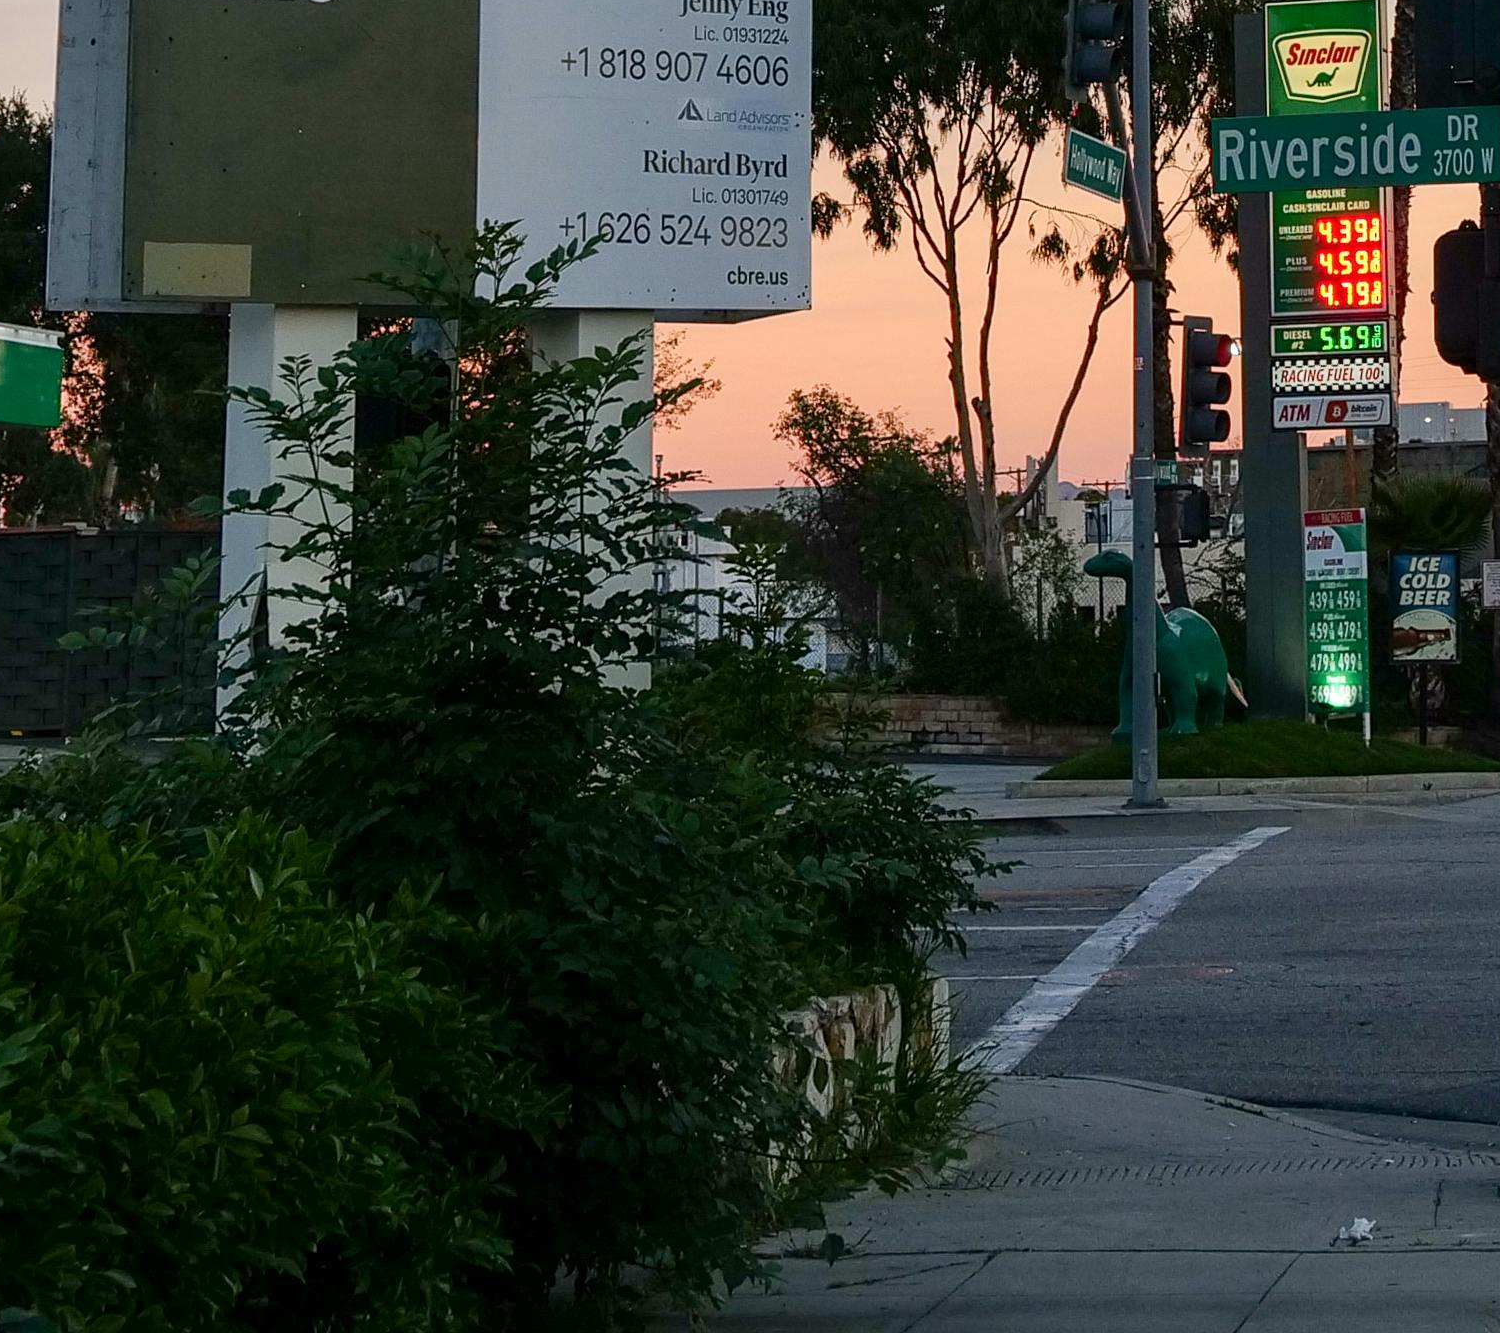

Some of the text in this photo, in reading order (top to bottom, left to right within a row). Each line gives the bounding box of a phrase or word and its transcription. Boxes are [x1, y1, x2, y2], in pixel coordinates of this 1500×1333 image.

[694, 26, 789, 45] Lic. 01931224
[1285, 41, 1361, 66] Sinclair
[560, 47, 789, 87] +1 818 907 4606
[706, 108, 790, 125] Land Advisors
[1447, 113, 1478, 142] DR
[1218, 122, 1421, 182] Riverside
[643, 149, 789, 183] Richard Byrd
[1070, 143, 1122, 193] Hollywood Way
[1433, 147, 1494, 177] 3700 W
[692, 188, 789, 206] Lic. 01301749
[1306, 188, 1346, 199] GASOLINE
[1347, 200, 1370, 210] CARD
[559, 212, 789, 248] +1 626 524 9823
[1285, 257, 1307, 265] PLUS
[727, 265, 789, 286] cbre.us
[1280, 287, 1315, 297] PREMIUM
[1283, 330, 1312, 340] DIESEL
[1291, 341, 1305, 350] #2
[1281, 367, 1380, 383] RACING FUEL 100
[1279, 404, 1311, 422] ATM
[1351, 403, 1378, 413] bitcoin
[1409, 556, 1441, 572] ICE
[1399, 573, 1451, 589] COLD
[1399, 590, 1451, 605] BEER
